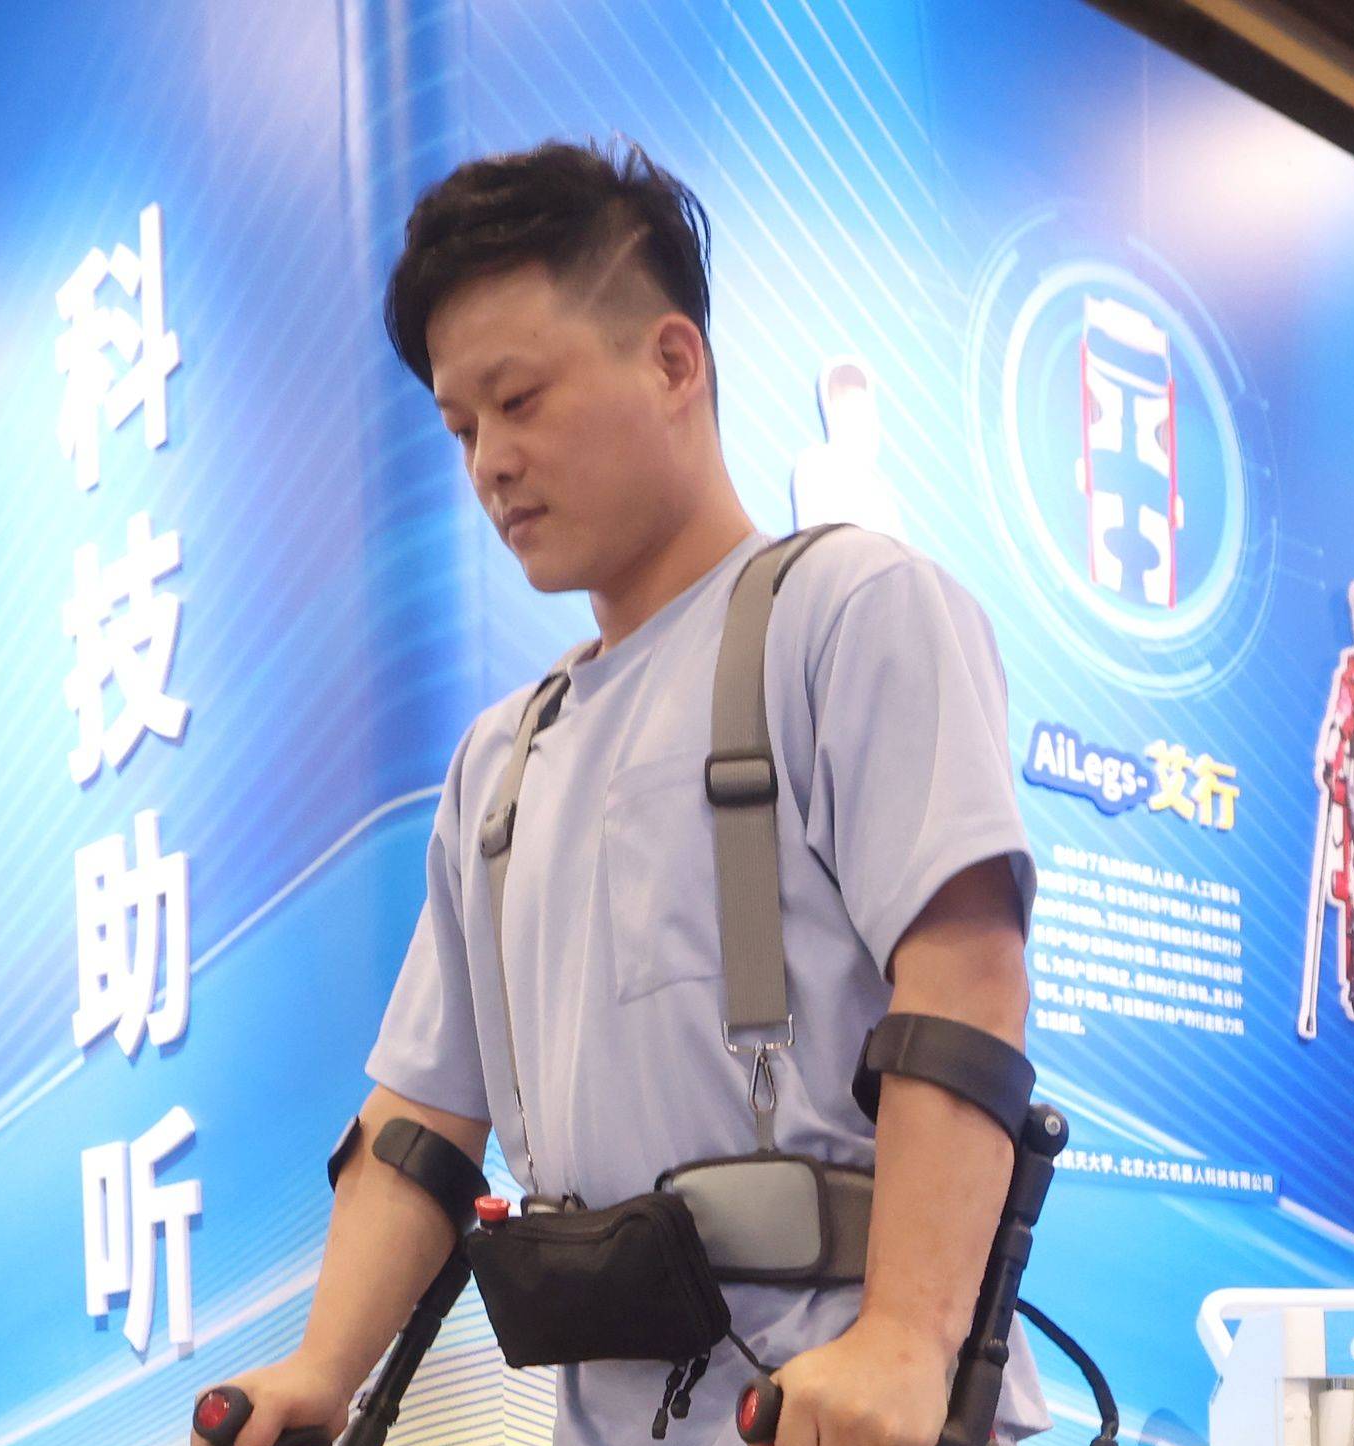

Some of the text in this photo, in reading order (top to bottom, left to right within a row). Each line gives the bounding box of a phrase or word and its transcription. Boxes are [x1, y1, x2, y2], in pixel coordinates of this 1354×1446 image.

[53, 201, 203, 1356] 科技助听
[1033, 730, 1240, 830] AiLegs-艾行
